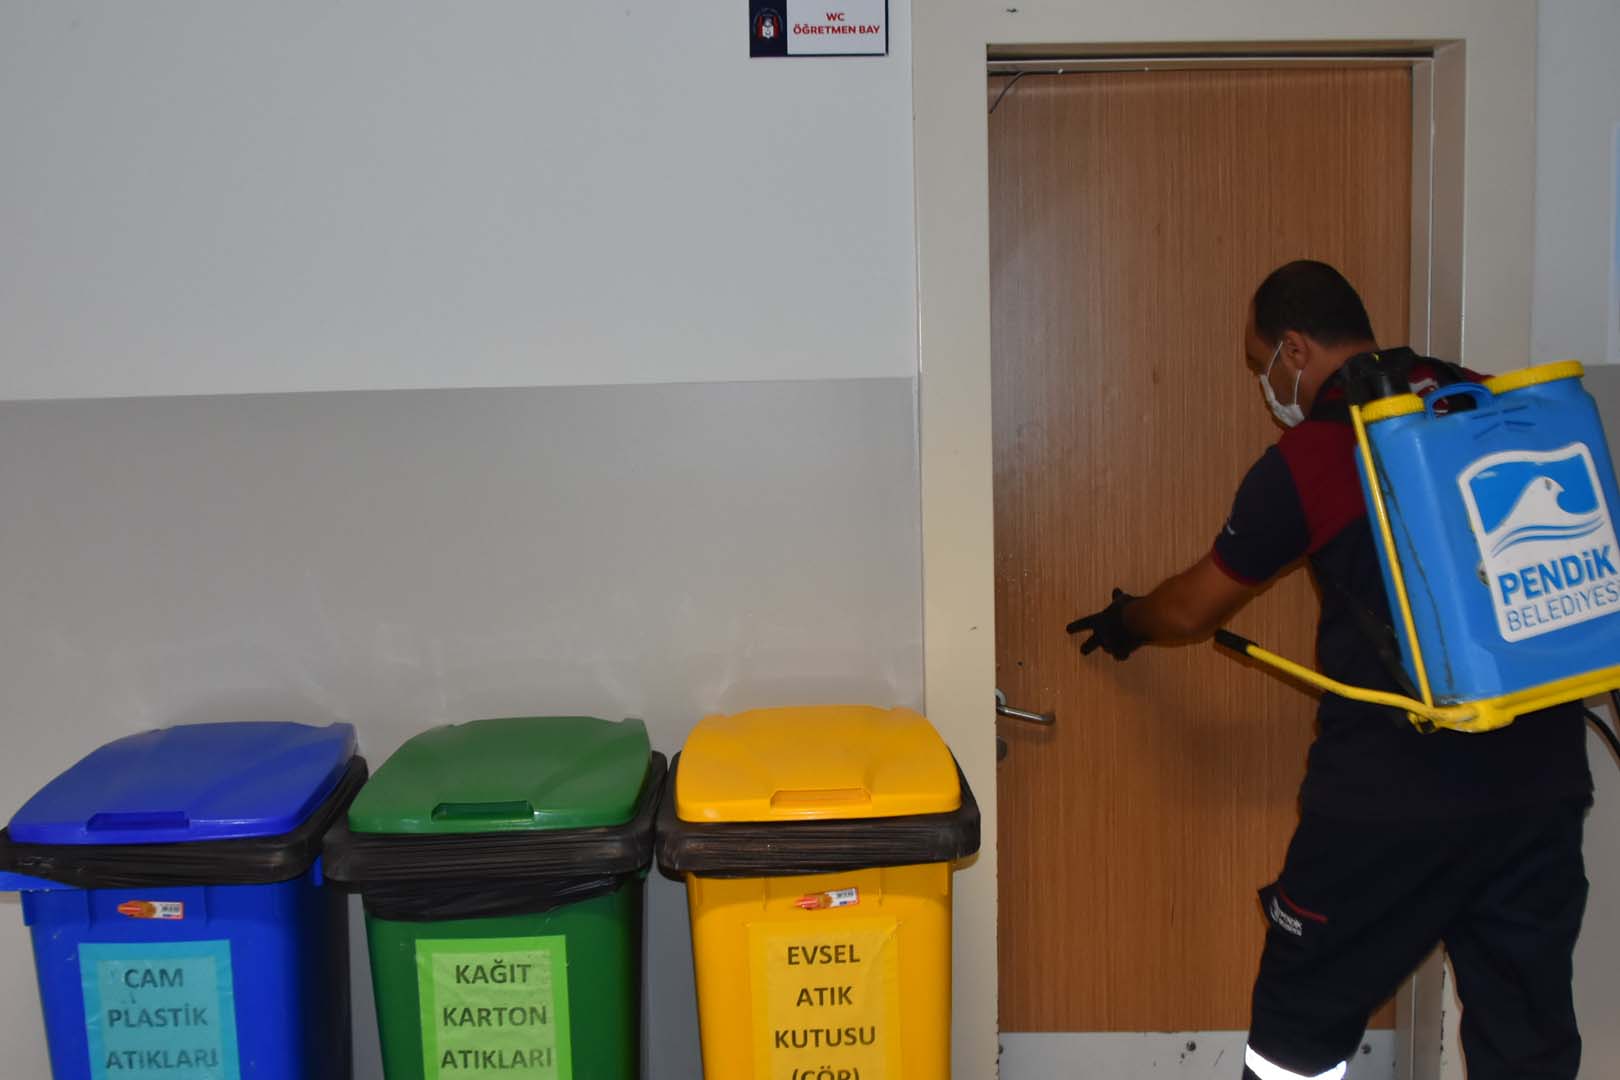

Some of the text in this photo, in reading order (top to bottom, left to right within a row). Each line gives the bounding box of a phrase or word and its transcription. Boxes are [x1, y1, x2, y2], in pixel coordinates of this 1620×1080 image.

[826, 12, 845, 22] WC
[793, 23, 880, 35] ÖĞRETMEN BAY
[1506, 579, 1620, 632] BELEDiYES
[787, 944, 861, 966] EVSEL
[124, 968, 184, 989] CAM
[455, 958, 532, 984] KAĞIT
[796, 986, 853, 1007] ATIK
[107, 1003, 208, 1028] PLASTİK
[443, 1006, 547, 1027] KARTON
[775, 1026, 876, 1048] KUTUSU
[105, 1048, 218, 1070] ATIKLARI
[441, 1048, 555, 1070] ATIKLARI
